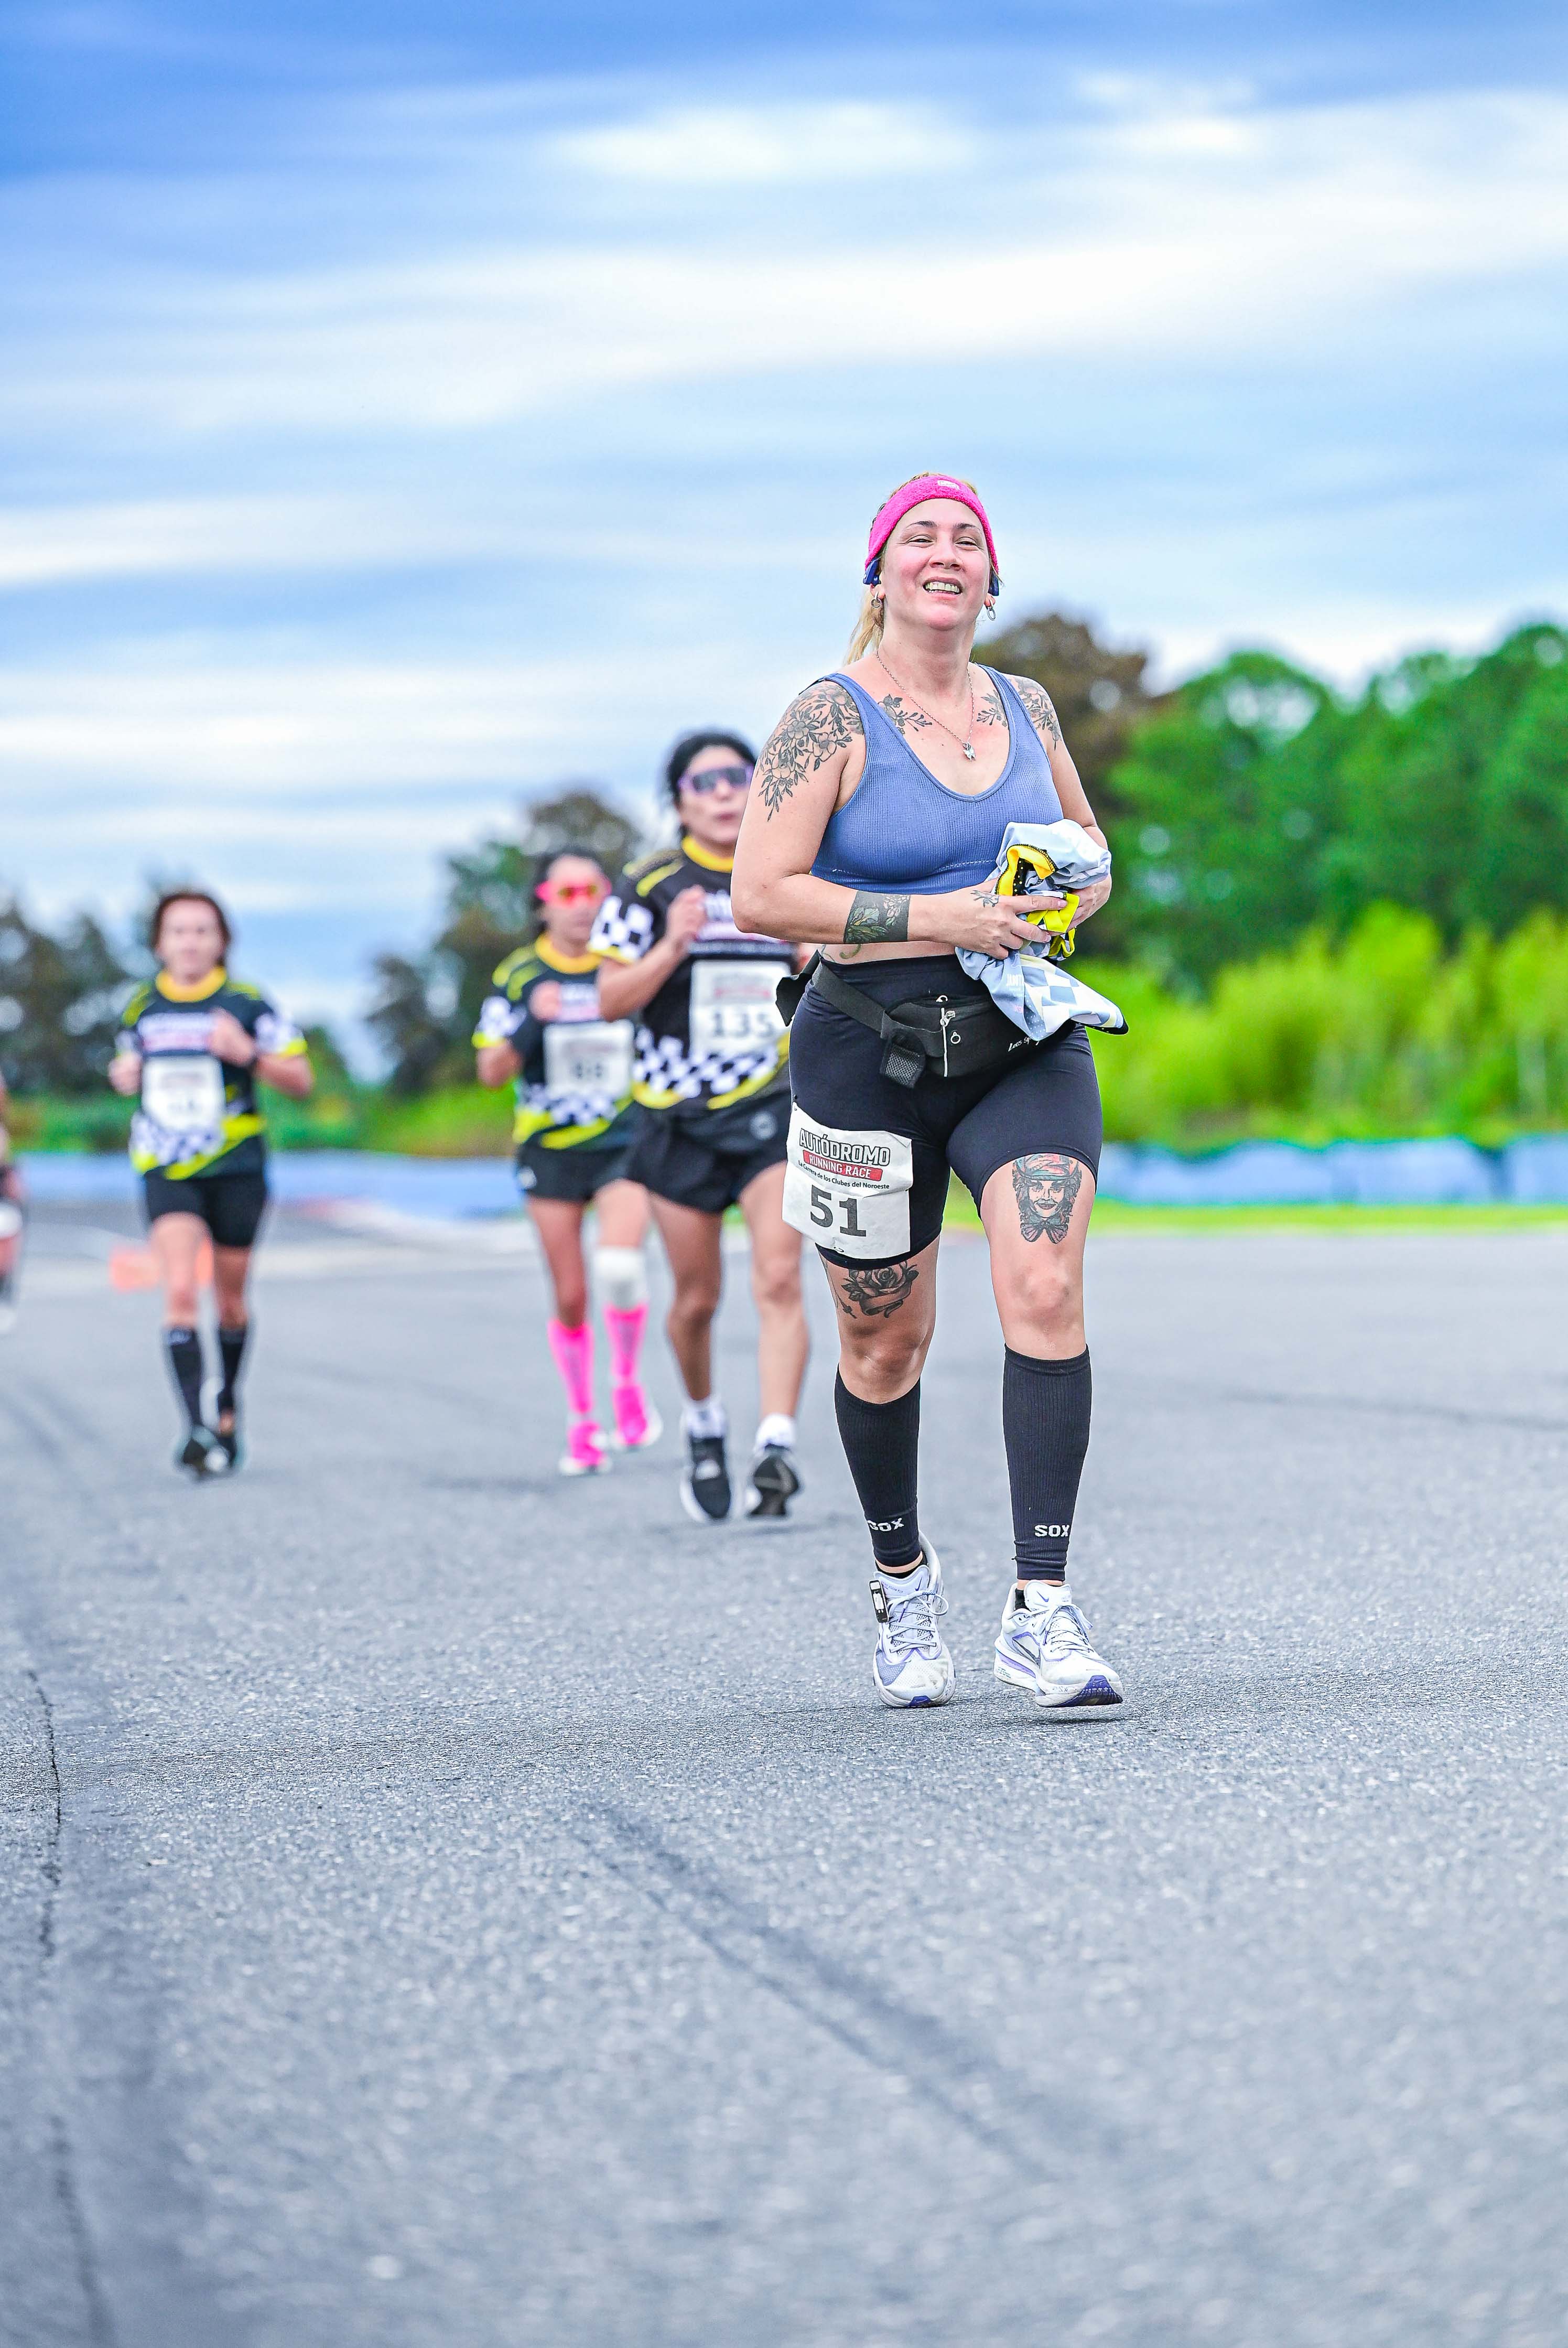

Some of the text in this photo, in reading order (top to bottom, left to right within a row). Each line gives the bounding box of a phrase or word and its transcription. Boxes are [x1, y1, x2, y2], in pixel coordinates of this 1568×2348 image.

[799, 1128, 891, 1167] AUTÓDROMO
[803, 1164, 817, 1176] Carrera
[831, 1178, 851, 1187] Clubes
[809, 1154, 872, 1179] RUNNING RACE
[810, 1184, 867, 1237] 51
[1034, 1524, 1070, 1537] SOX
